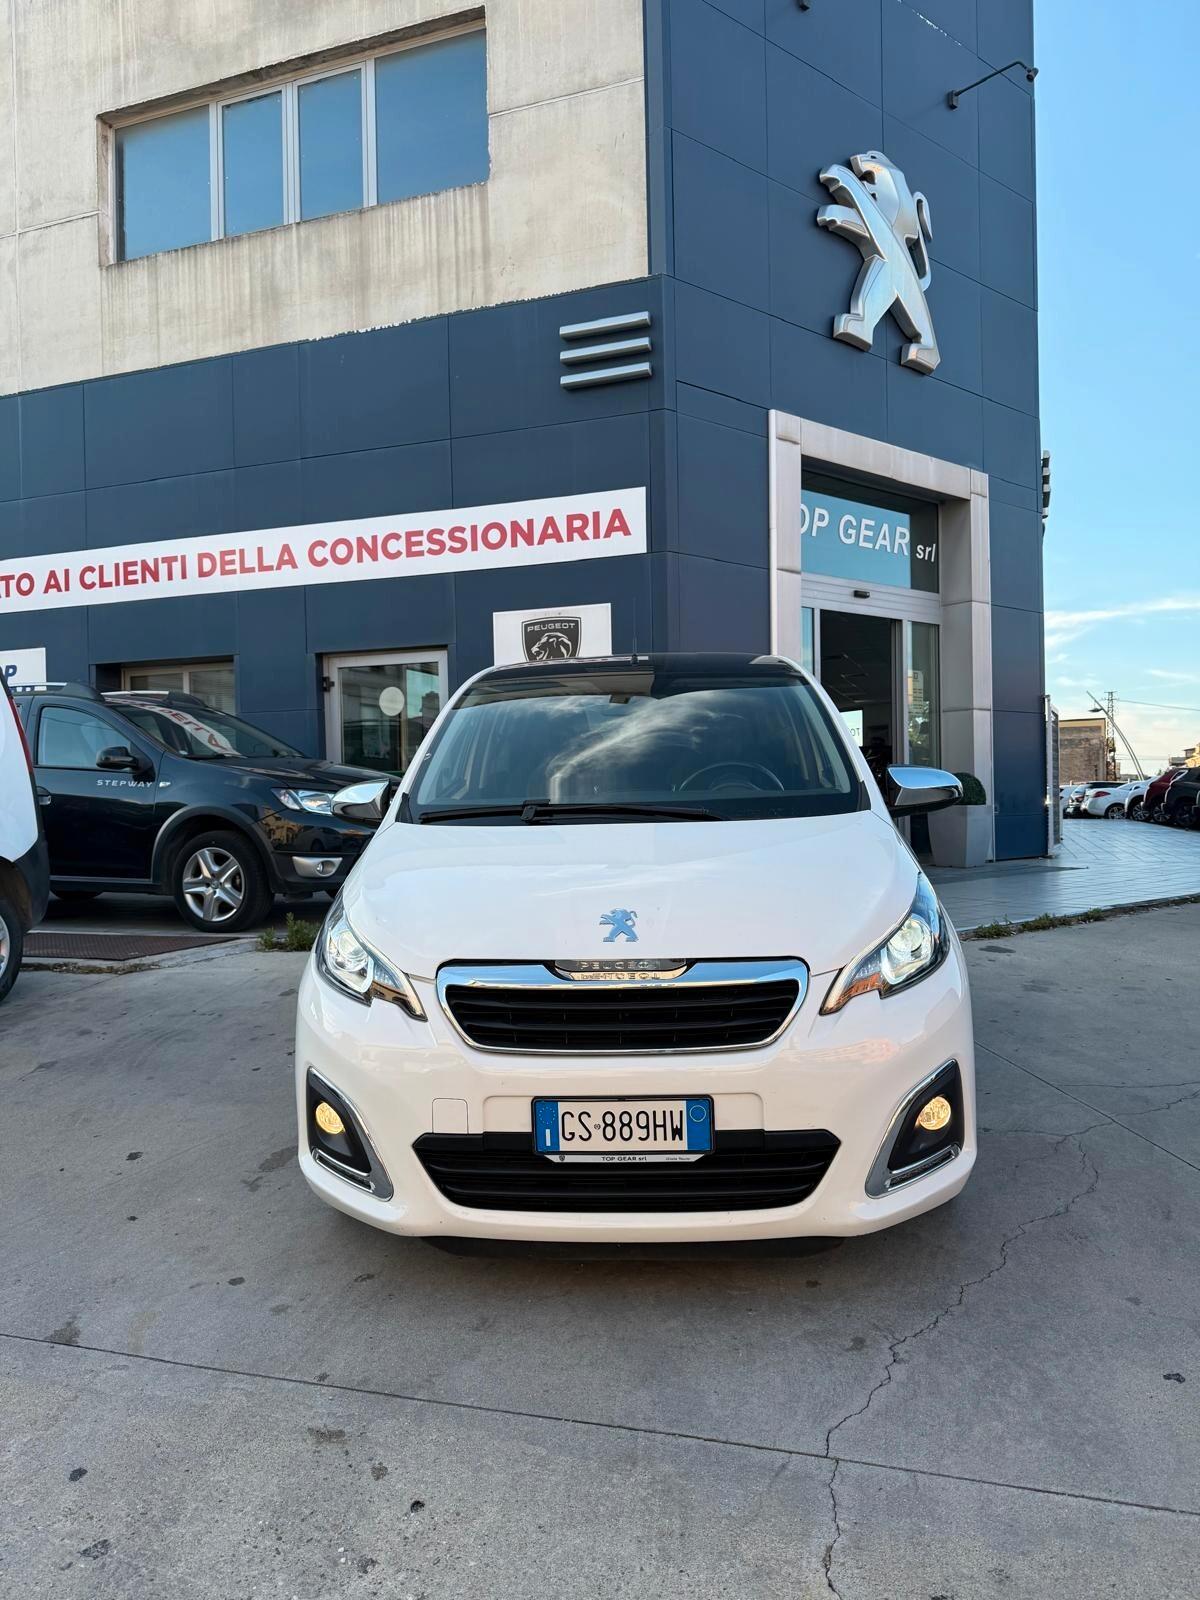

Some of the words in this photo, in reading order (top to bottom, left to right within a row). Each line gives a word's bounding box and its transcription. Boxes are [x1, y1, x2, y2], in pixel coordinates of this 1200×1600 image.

[0, 573, 35, 598] TO
[43, 568, 70, 594] AI
[79, 554, 187, 591] CLIENTI
[197, 544, 298, 578] DELLA
[307, 508, 632, 568] CONCESSIONARIA
[839, 514, 911, 556] GEAR
[916, 543, 937, 563] srl
[527, 622, 576, 632] PEUGEOT
[96, 779, 153, 788] STEPWAY
